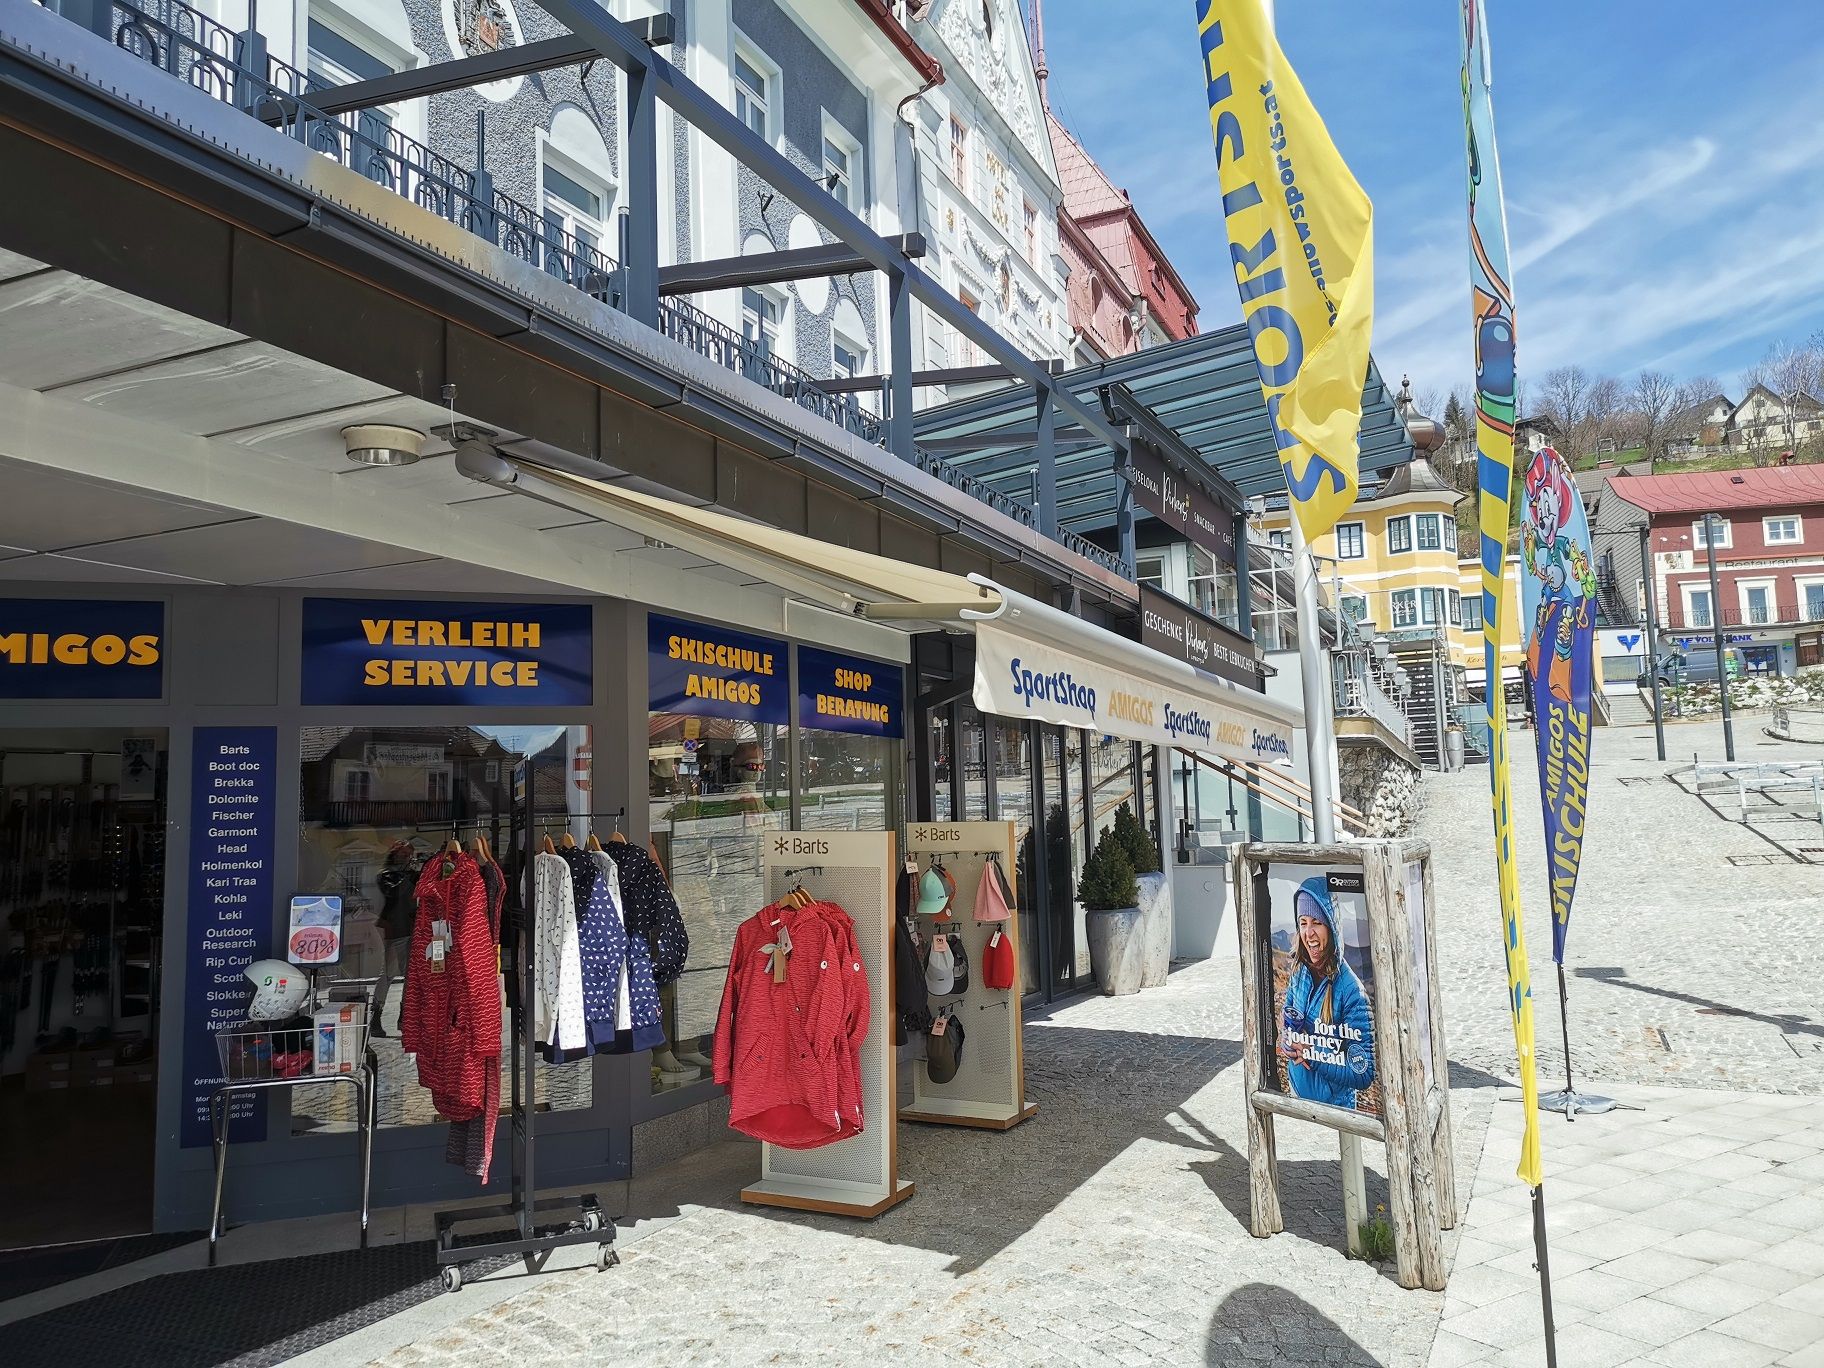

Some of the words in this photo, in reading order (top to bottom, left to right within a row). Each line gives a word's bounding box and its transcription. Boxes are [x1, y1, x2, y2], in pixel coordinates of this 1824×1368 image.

[1725, 557, 1799, 569] Restaurant
[361, 619, 541, 648] VERLEIH
[1144, 611, 1182, 642] GESCHENKE
[0, 633, 160, 666] MIGOS
[668, 635, 773, 676] SKISCHULE
[1213, 643, 1228, 661] BESTE
[1229, 650, 1256, 674] LEBKUCHEN
[364, 660, 539, 687] SERVICE
[834, 667, 872, 692] SHOP
[685, 674, 761, 706] AMIGOS
[816, 694, 889, 723] BERATUNG
[1010, 658, 1096, 720] SportShop
[1108, 690, 1154, 727] AMIGOS
[1164, 703, 1211, 746] SportShop
[1216, 720, 1246, 748] AMIGOS
[220, 745, 250, 755] Barts
[1546, 702, 1564, 813] AMIGOS
[209, 762, 236, 771] Boot
[239, 762, 260, 770] doc
[214, 778, 254, 787] Brekka
[208, 794, 259, 804] Dolomite
[212, 811, 254, 820] Fischer
[1552, 704, 1588, 925] SKISCHULE
[208, 828, 258, 837] Garmont
[930, 827, 960, 841] Barts
[218, 844, 248, 853] Head
[793, 837, 829, 855] Barts
[202, 860, 263, 870] Holmenkol
[206, 878, 229, 887] Kari
[232, 877, 257, 886] Traa
[214, 894, 247, 904] Kohla
[219, 911, 242, 920] Leki
[206, 928, 253, 938] Outdoor
[203, 939, 256, 950] Research
[296, 938, 335, 954] 80%
[206, 957, 225, 968] Rip
[229, 955, 253, 966] Curl
[214, 973, 244, 983] Scott
[211, 1008, 245, 1018] Super
[1313, 1017, 1337, 1037] for
[1339, 1022, 1362, 1041] the
[1285, 1027, 1343, 1054] journey
[1302, 1046, 1346, 1066] ahead
